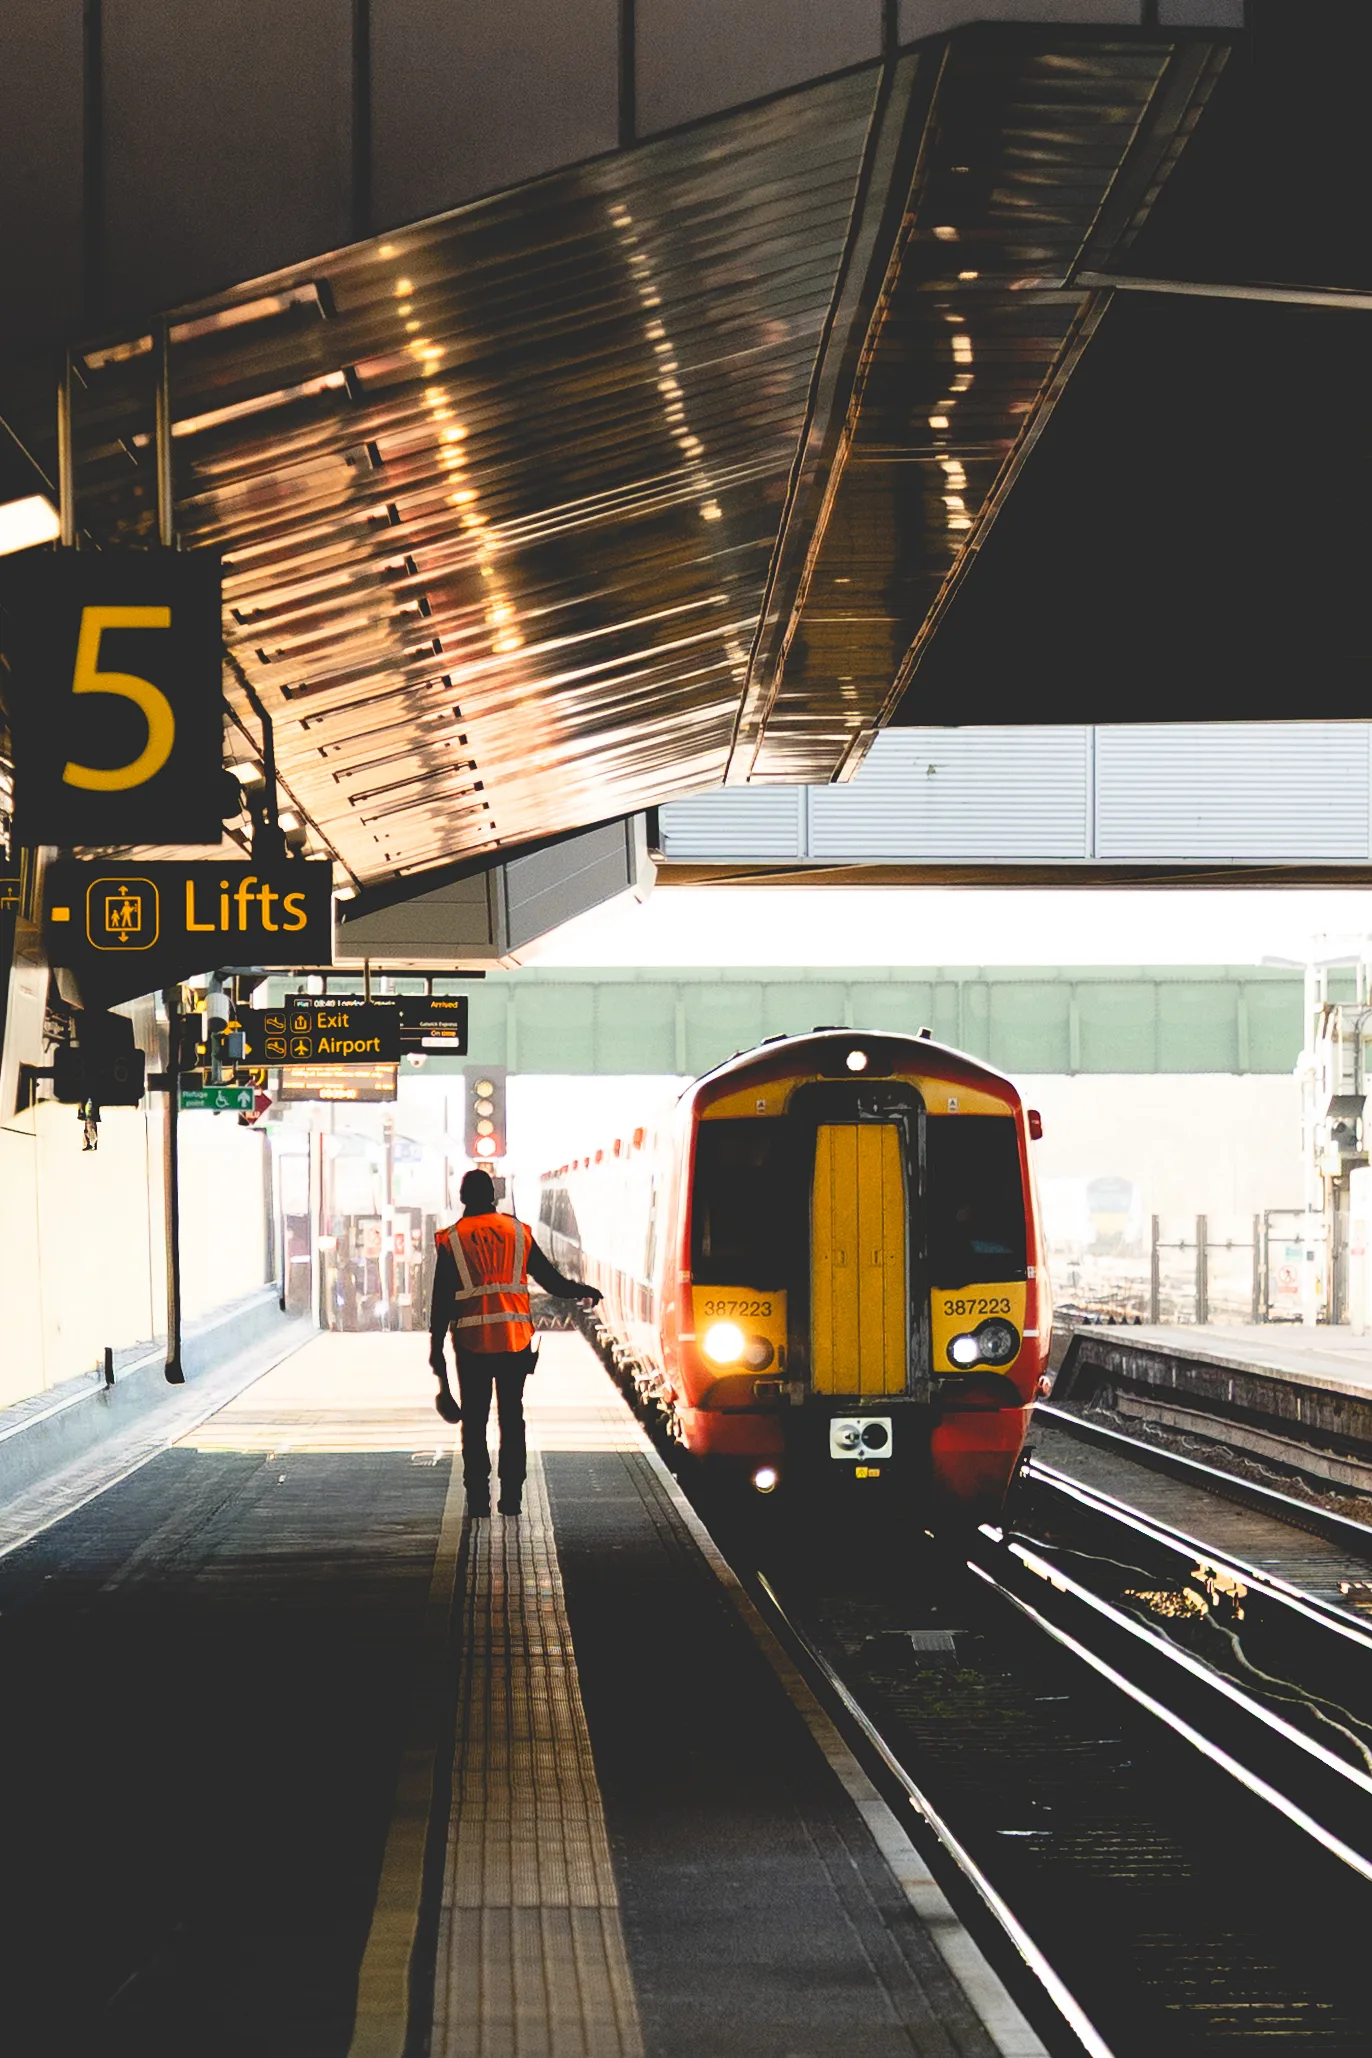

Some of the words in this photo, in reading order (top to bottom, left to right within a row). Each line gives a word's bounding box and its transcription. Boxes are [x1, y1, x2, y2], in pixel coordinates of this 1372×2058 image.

[62, 605, 176, 793] 5
[185, 876, 307, 933] Lifts
[430, 1001, 459, 1009] Arrived
[317, 1012, 350, 1029] Exit
[317, 1037, 380, 1057] Airport
[182, 1090, 208, 1099] Refuge
[186, 1100, 205, 1108] point
[704, 1300, 772, 1317] 387223
[943, 1297, 1011, 1316] 387223
